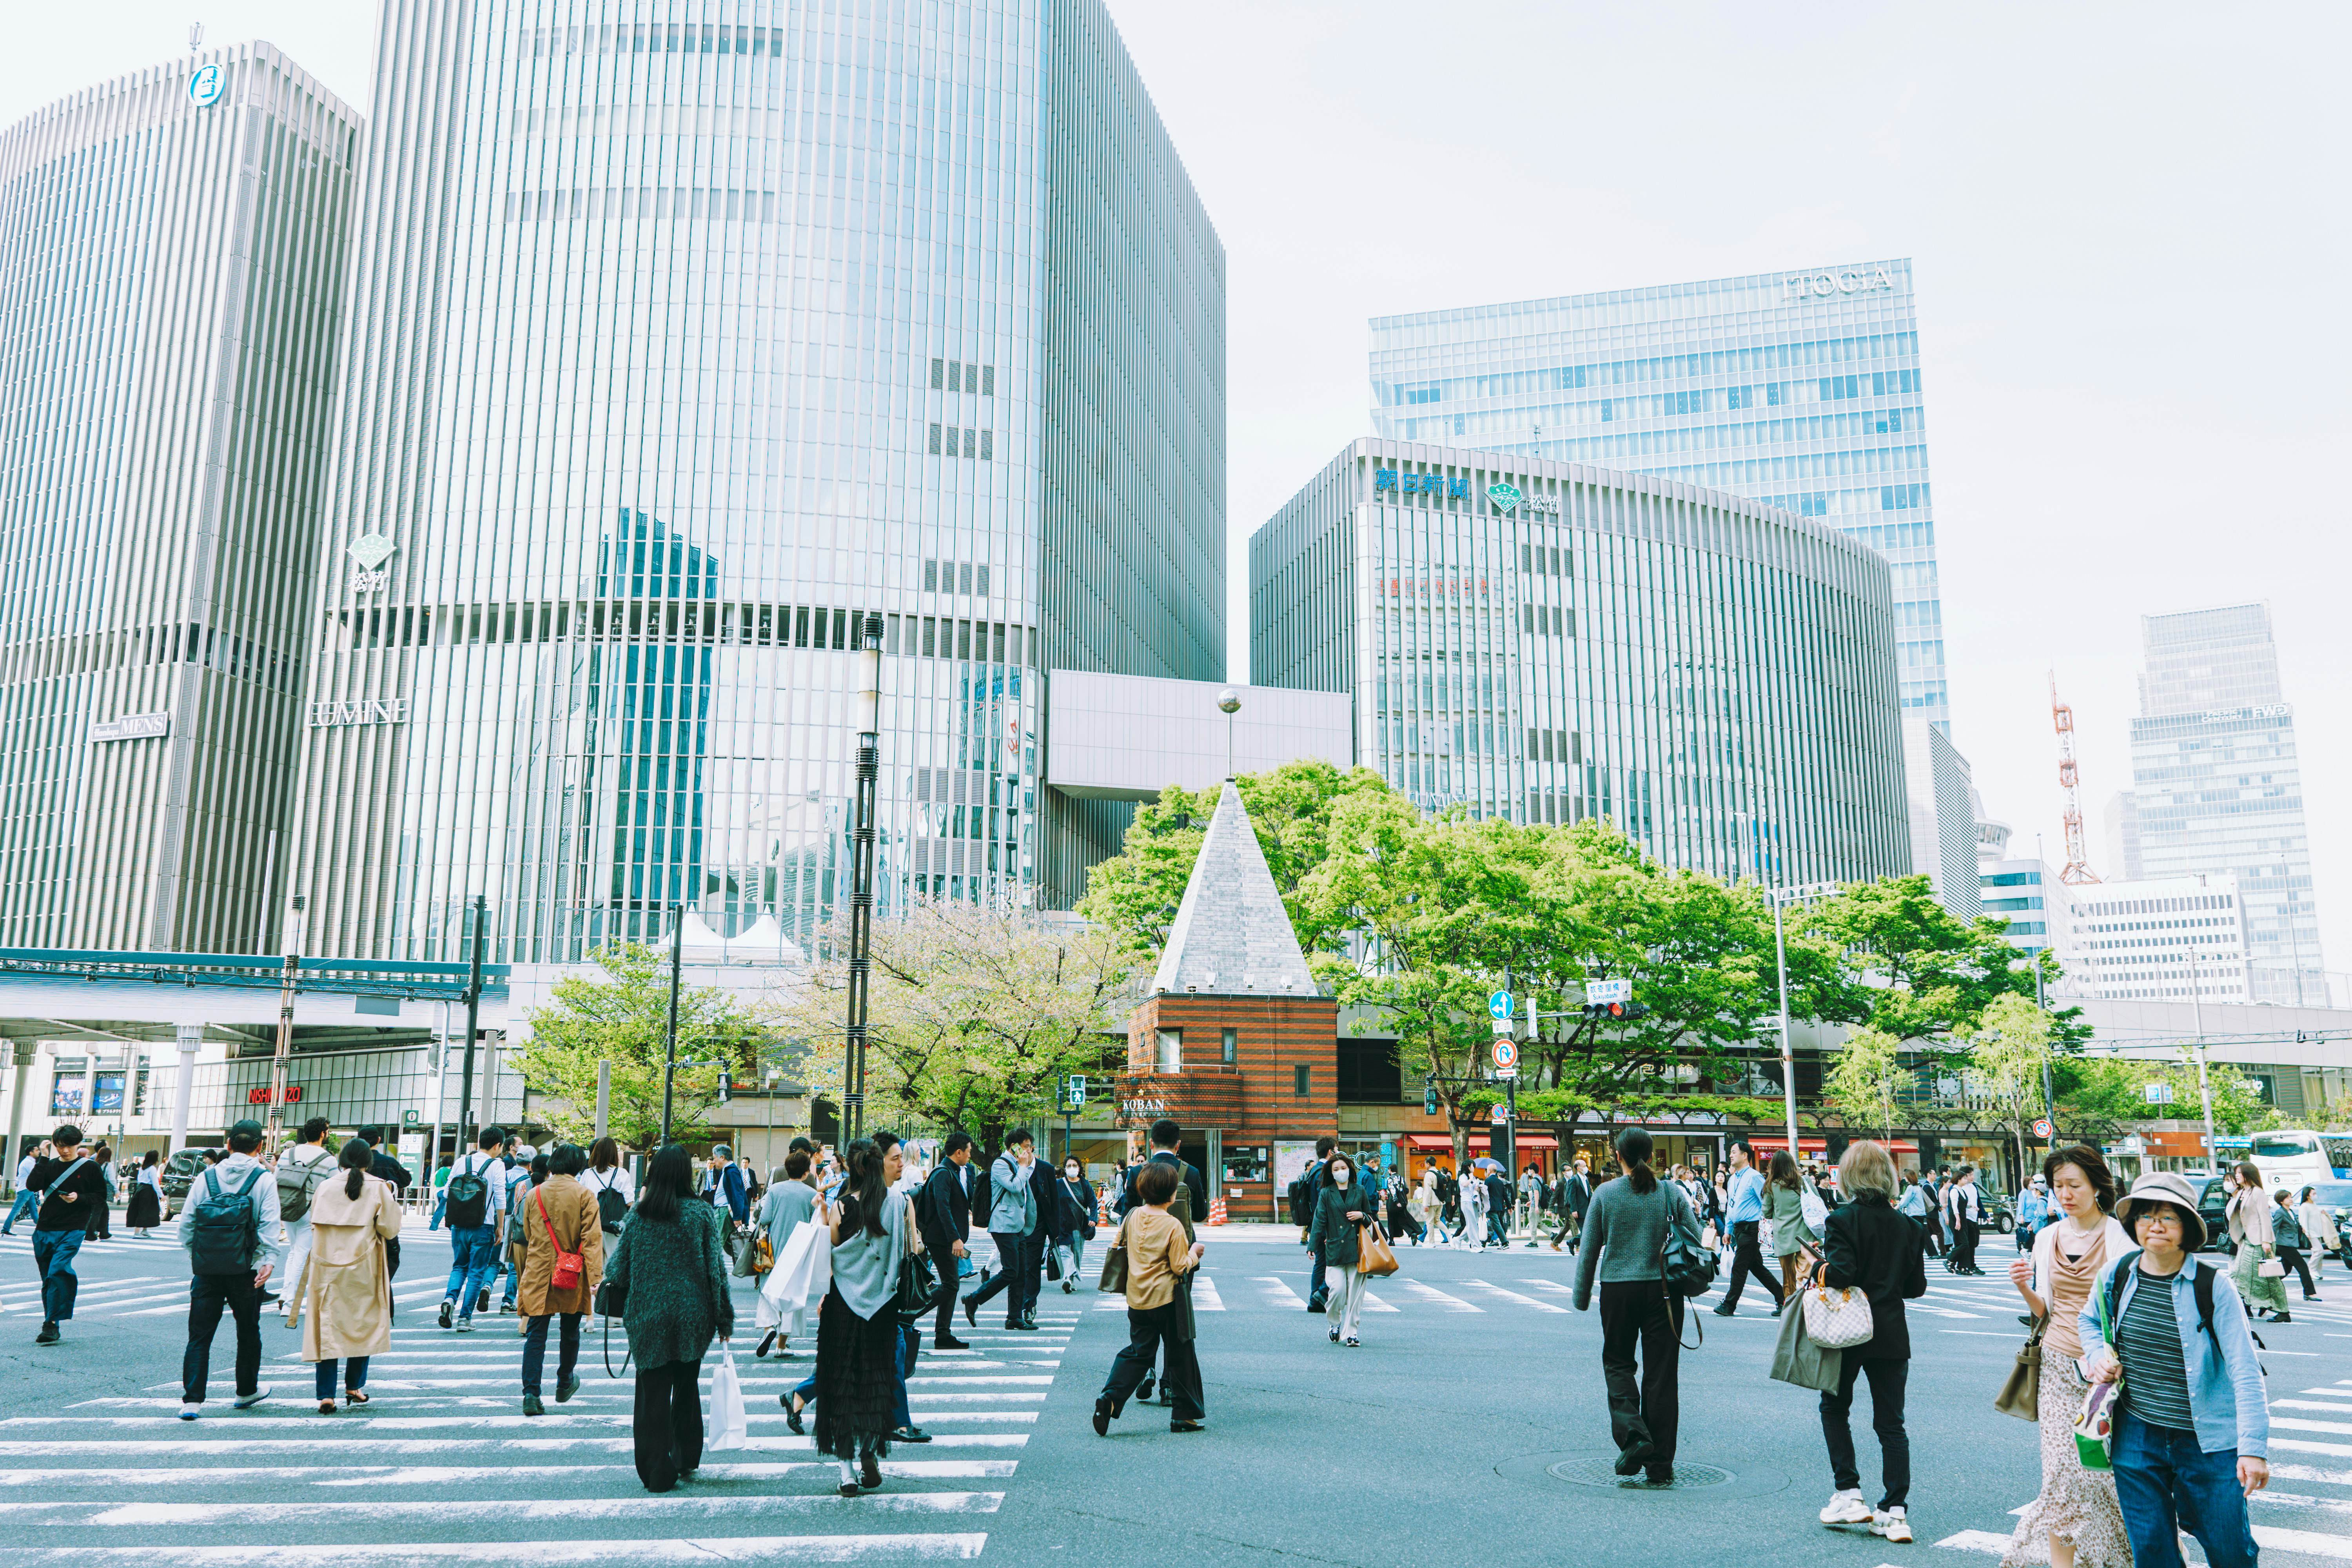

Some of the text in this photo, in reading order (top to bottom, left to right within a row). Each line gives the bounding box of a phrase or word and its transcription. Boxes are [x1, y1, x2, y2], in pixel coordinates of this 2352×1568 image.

[1376, 468, 1468, 499] 朝日新聞
[1527, 494, 1561, 513] 松竹
[349, 570, 388, 592] 松竹
[308, 699, 406, 726] LUMINE
[2253, 705, 2288, 718] FWD
[93, 727, 119, 738] Hankyu
[1590, 982, 1619, 993] 数寄屋橋
[249, 1087, 301, 1103] NISHIZA
[1123, 1099, 1165, 1109] KOBAN
